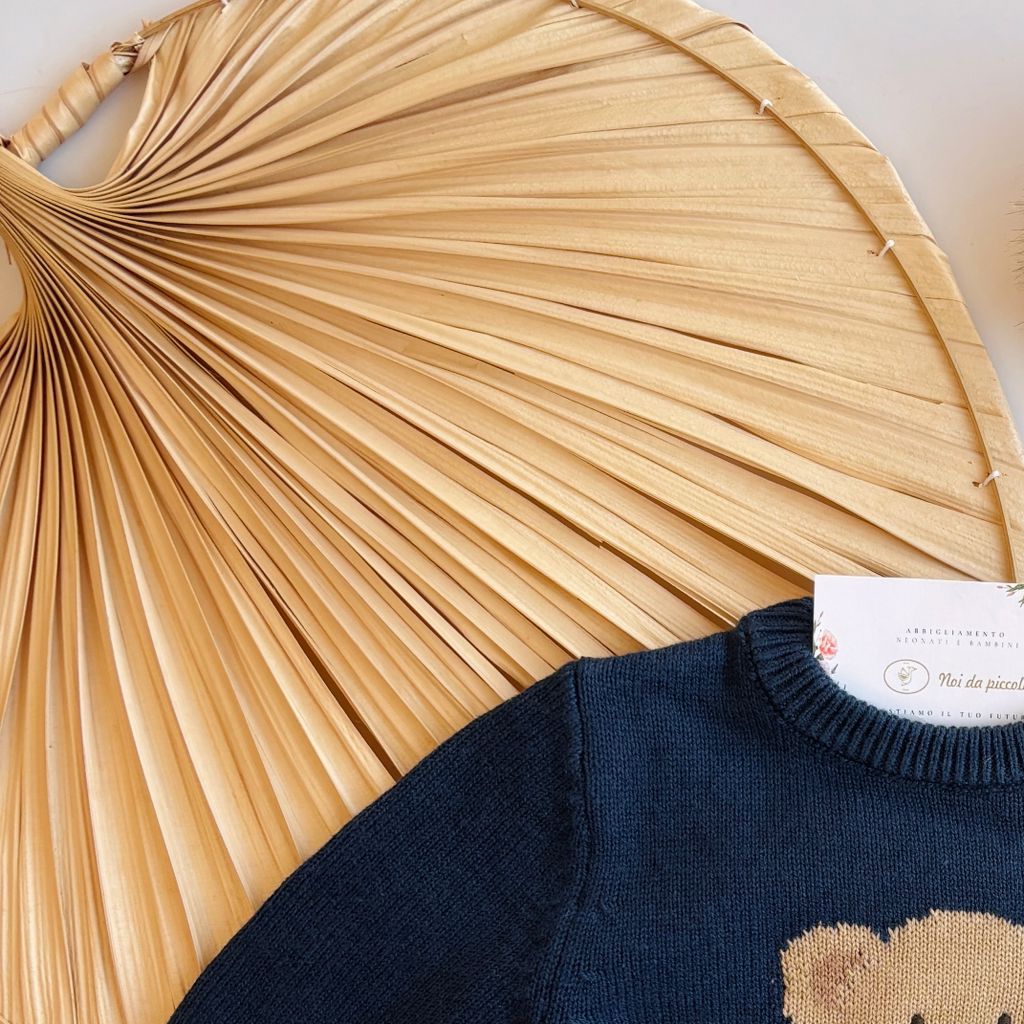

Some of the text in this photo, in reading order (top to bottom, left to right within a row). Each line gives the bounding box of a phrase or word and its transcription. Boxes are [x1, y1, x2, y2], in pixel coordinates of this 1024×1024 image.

[905, 627, 1006, 638] ABBIGLIAMENTO
[896, 637, 949, 645] NEONATI
[969, 639, 1020, 649] BAMBINI
[938, 672, 964, 688] Noi
[965, 674, 983, 689] da
[959, 711, 982, 719] TUO
